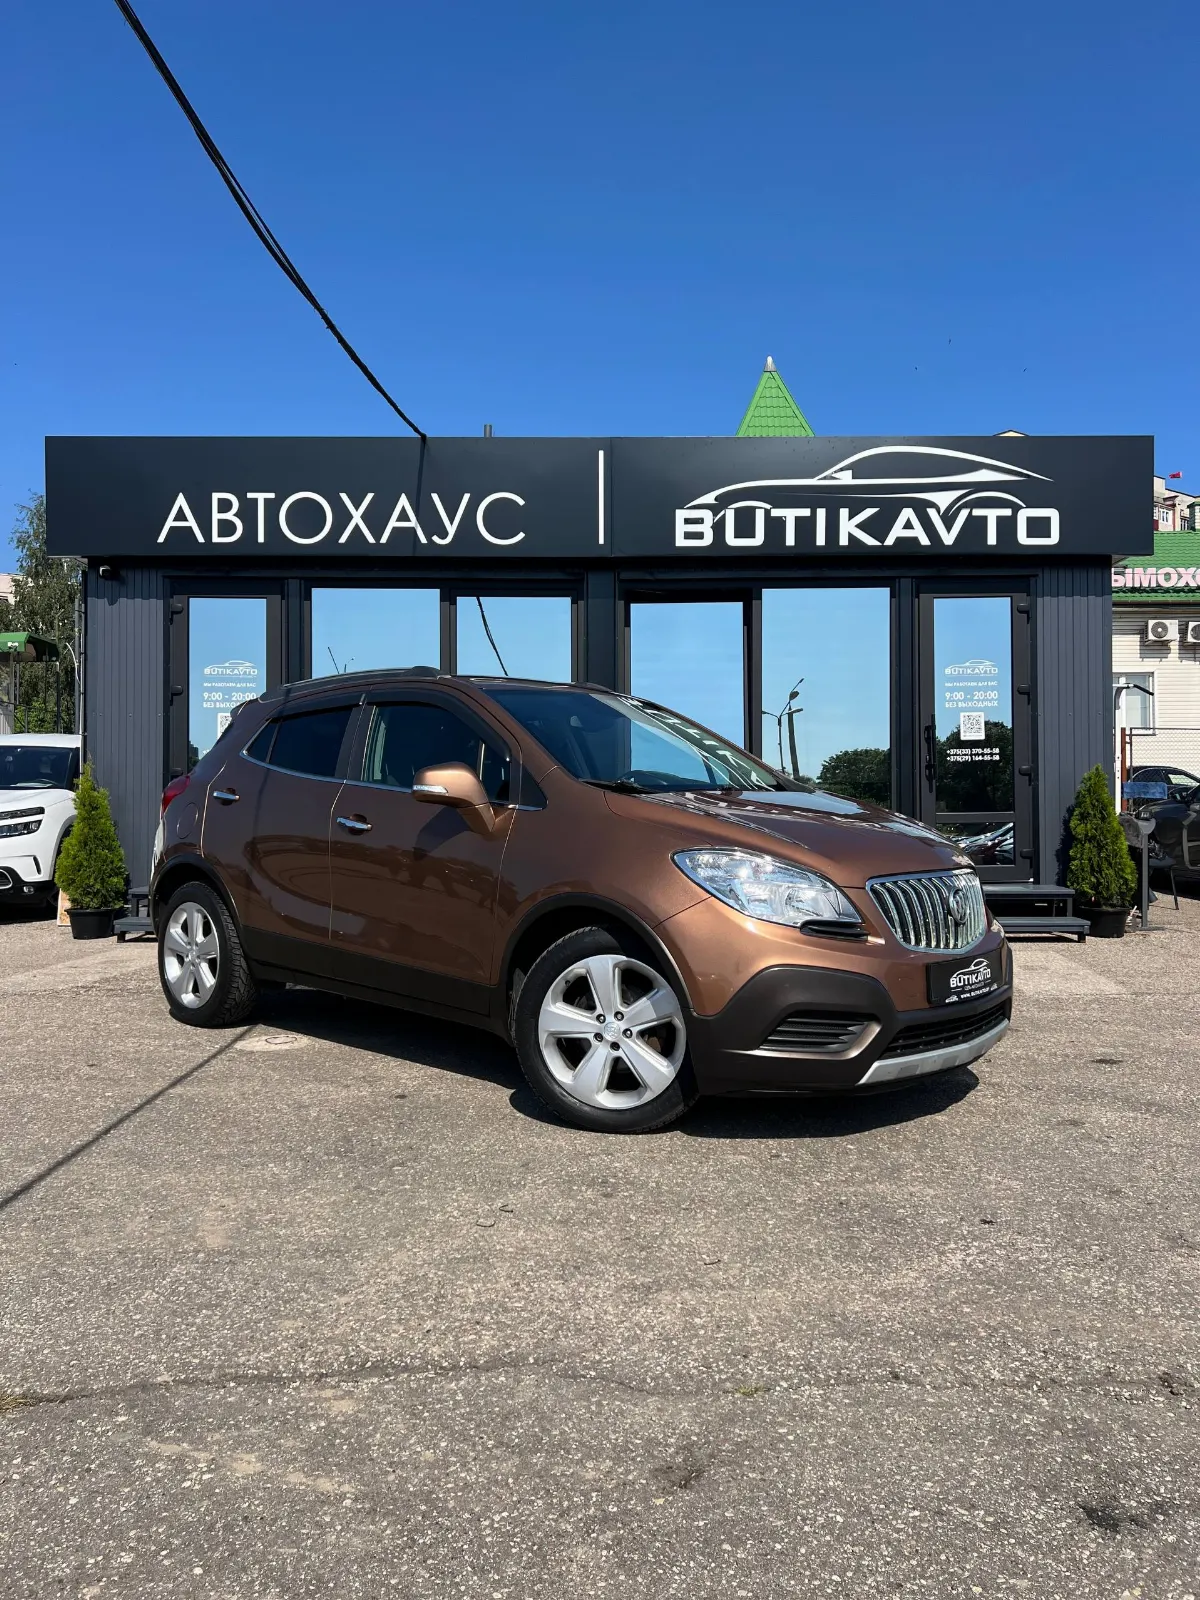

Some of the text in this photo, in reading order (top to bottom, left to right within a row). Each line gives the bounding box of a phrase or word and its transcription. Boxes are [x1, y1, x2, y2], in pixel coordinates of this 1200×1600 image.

[156, 491, 526, 546] АВТОХАУС
[675, 507, 1060, 547] BUTIKAVTO
[944, 667, 998, 675] BUTIKAVTO
[203, 692, 223, 701] 9:00
[231, 692, 257, 701] 20:00
[945, 691, 965, 701] 9:00
[973, 690, 998, 700] 20:00
[958, 700, 998, 708] ВЫХОДНЫХ
[950, 969, 991, 987] BUTIKAVTO
